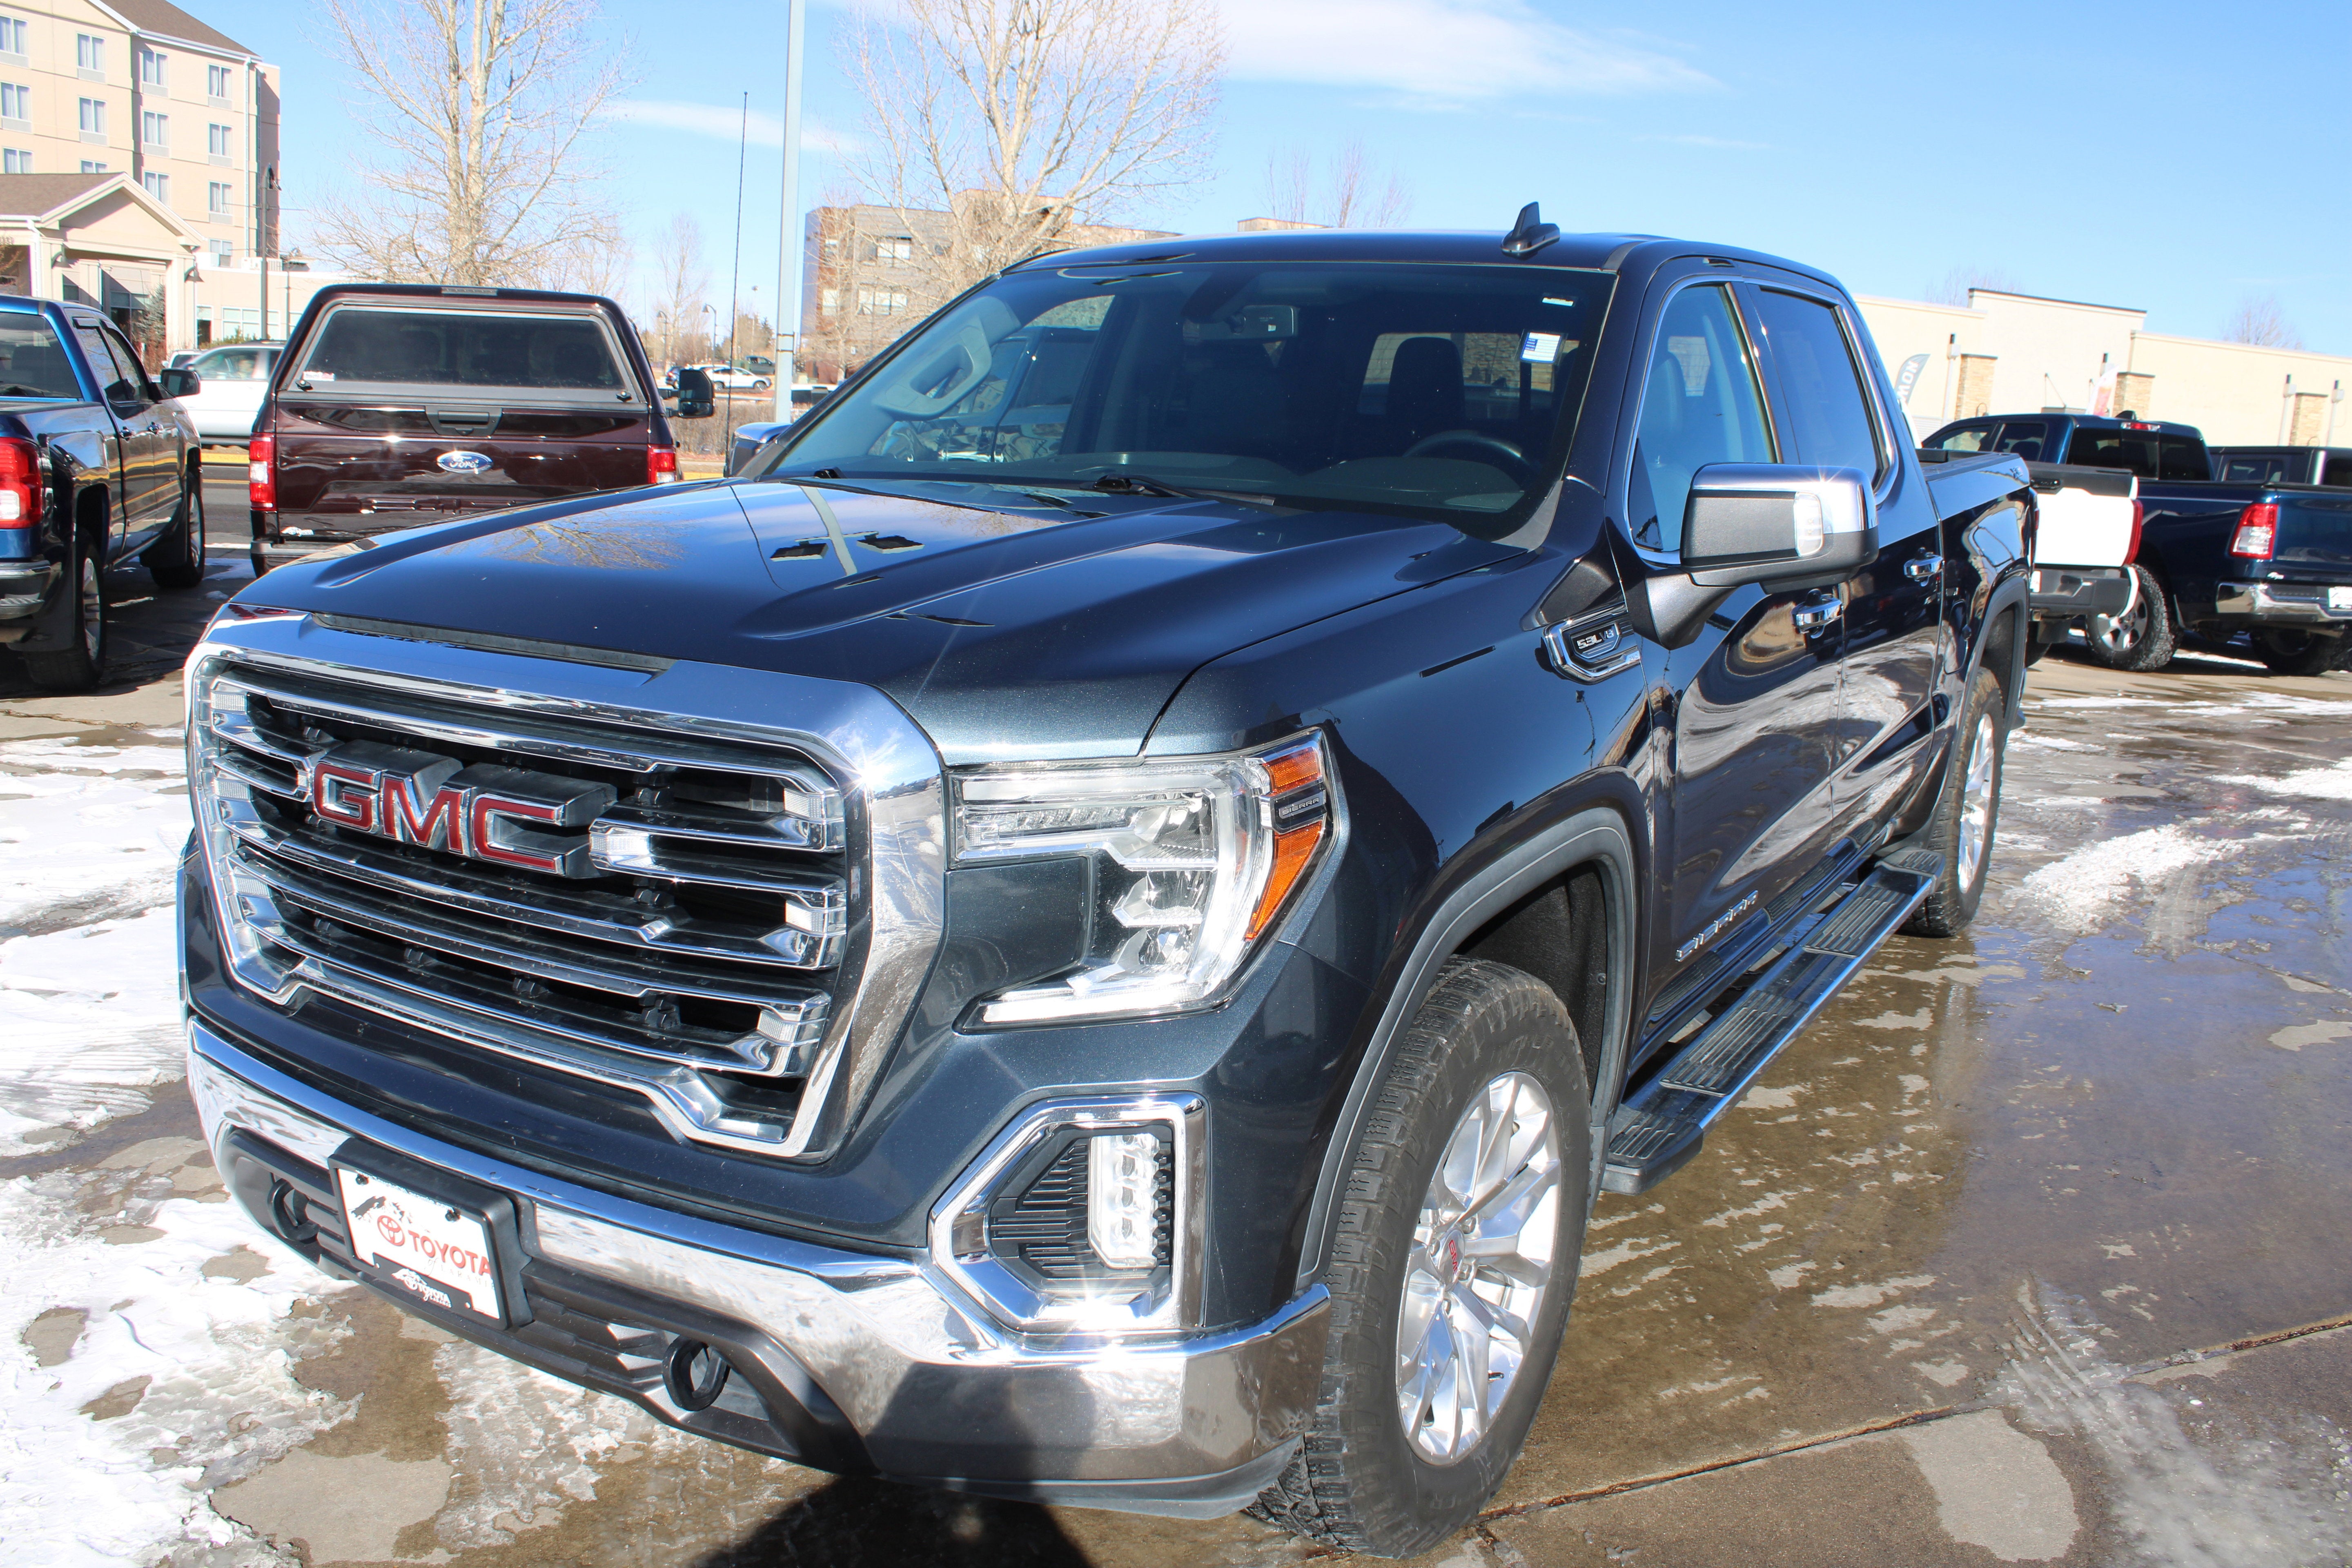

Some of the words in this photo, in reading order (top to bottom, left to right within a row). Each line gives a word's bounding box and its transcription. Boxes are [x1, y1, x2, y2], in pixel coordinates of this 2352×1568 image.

[450, 456, 479, 468] Ford
[1599, 628, 1615, 640] V8
[1282, 797, 1319, 815] SIERRA
[313, 760, 566, 877] GMC
[408, 1229, 492, 1276] TOYOTA
[1448, 1239, 1458, 1275] GM
[417, 1282, 451, 1304] TOYOTA
